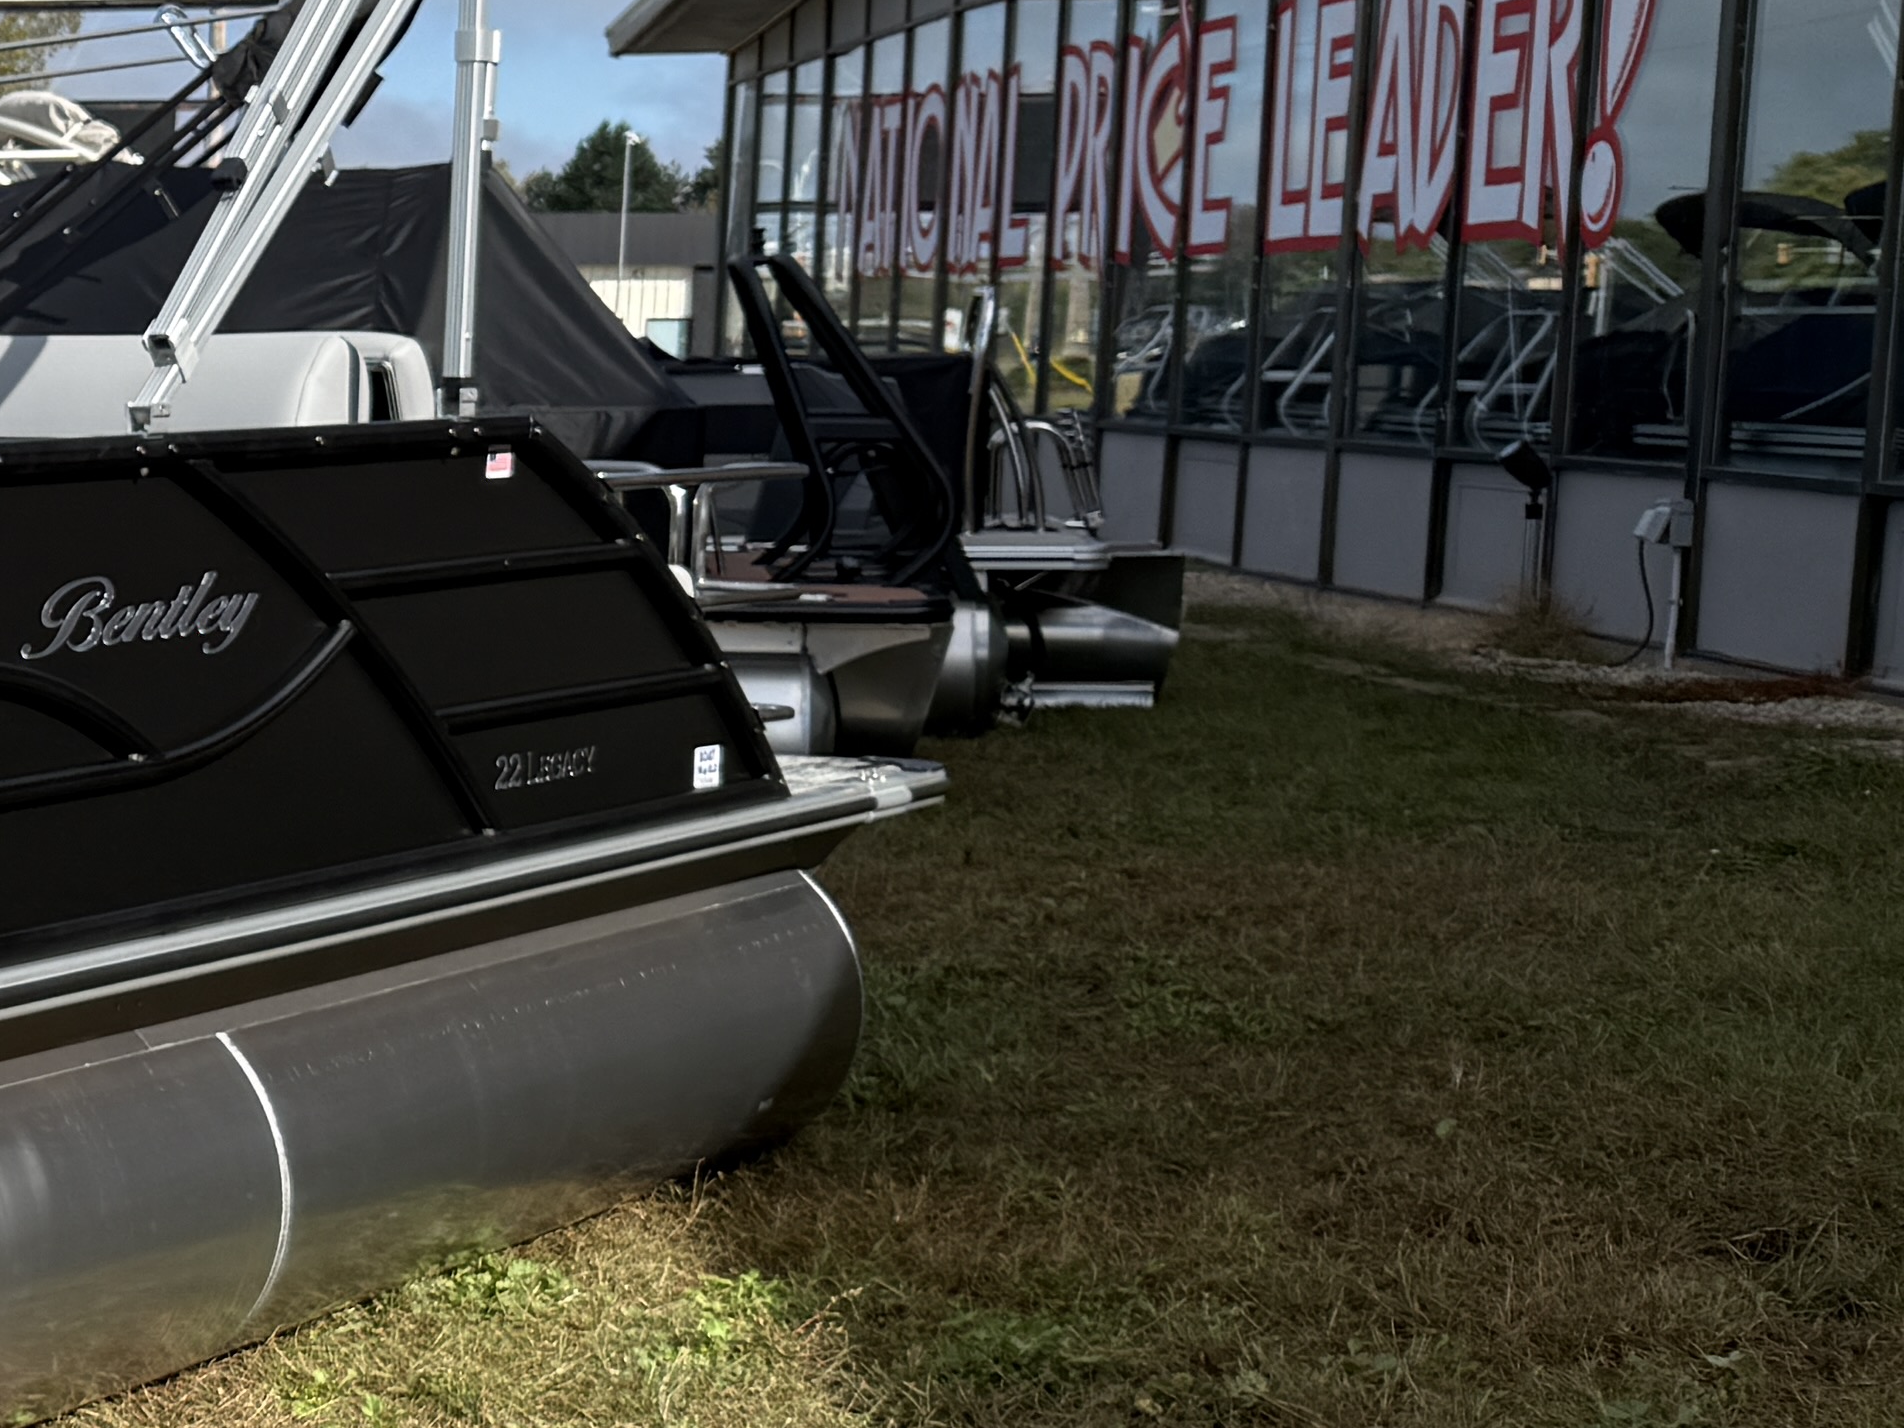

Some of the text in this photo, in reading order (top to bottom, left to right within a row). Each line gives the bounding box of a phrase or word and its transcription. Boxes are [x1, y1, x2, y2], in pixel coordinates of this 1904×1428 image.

[829, 66, 1030, 280] NATIONAL
[1050, 12, 1238, 270] PRICE
[20, 571, 259, 660] Bentley
[495, 753, 522, 790] 22
